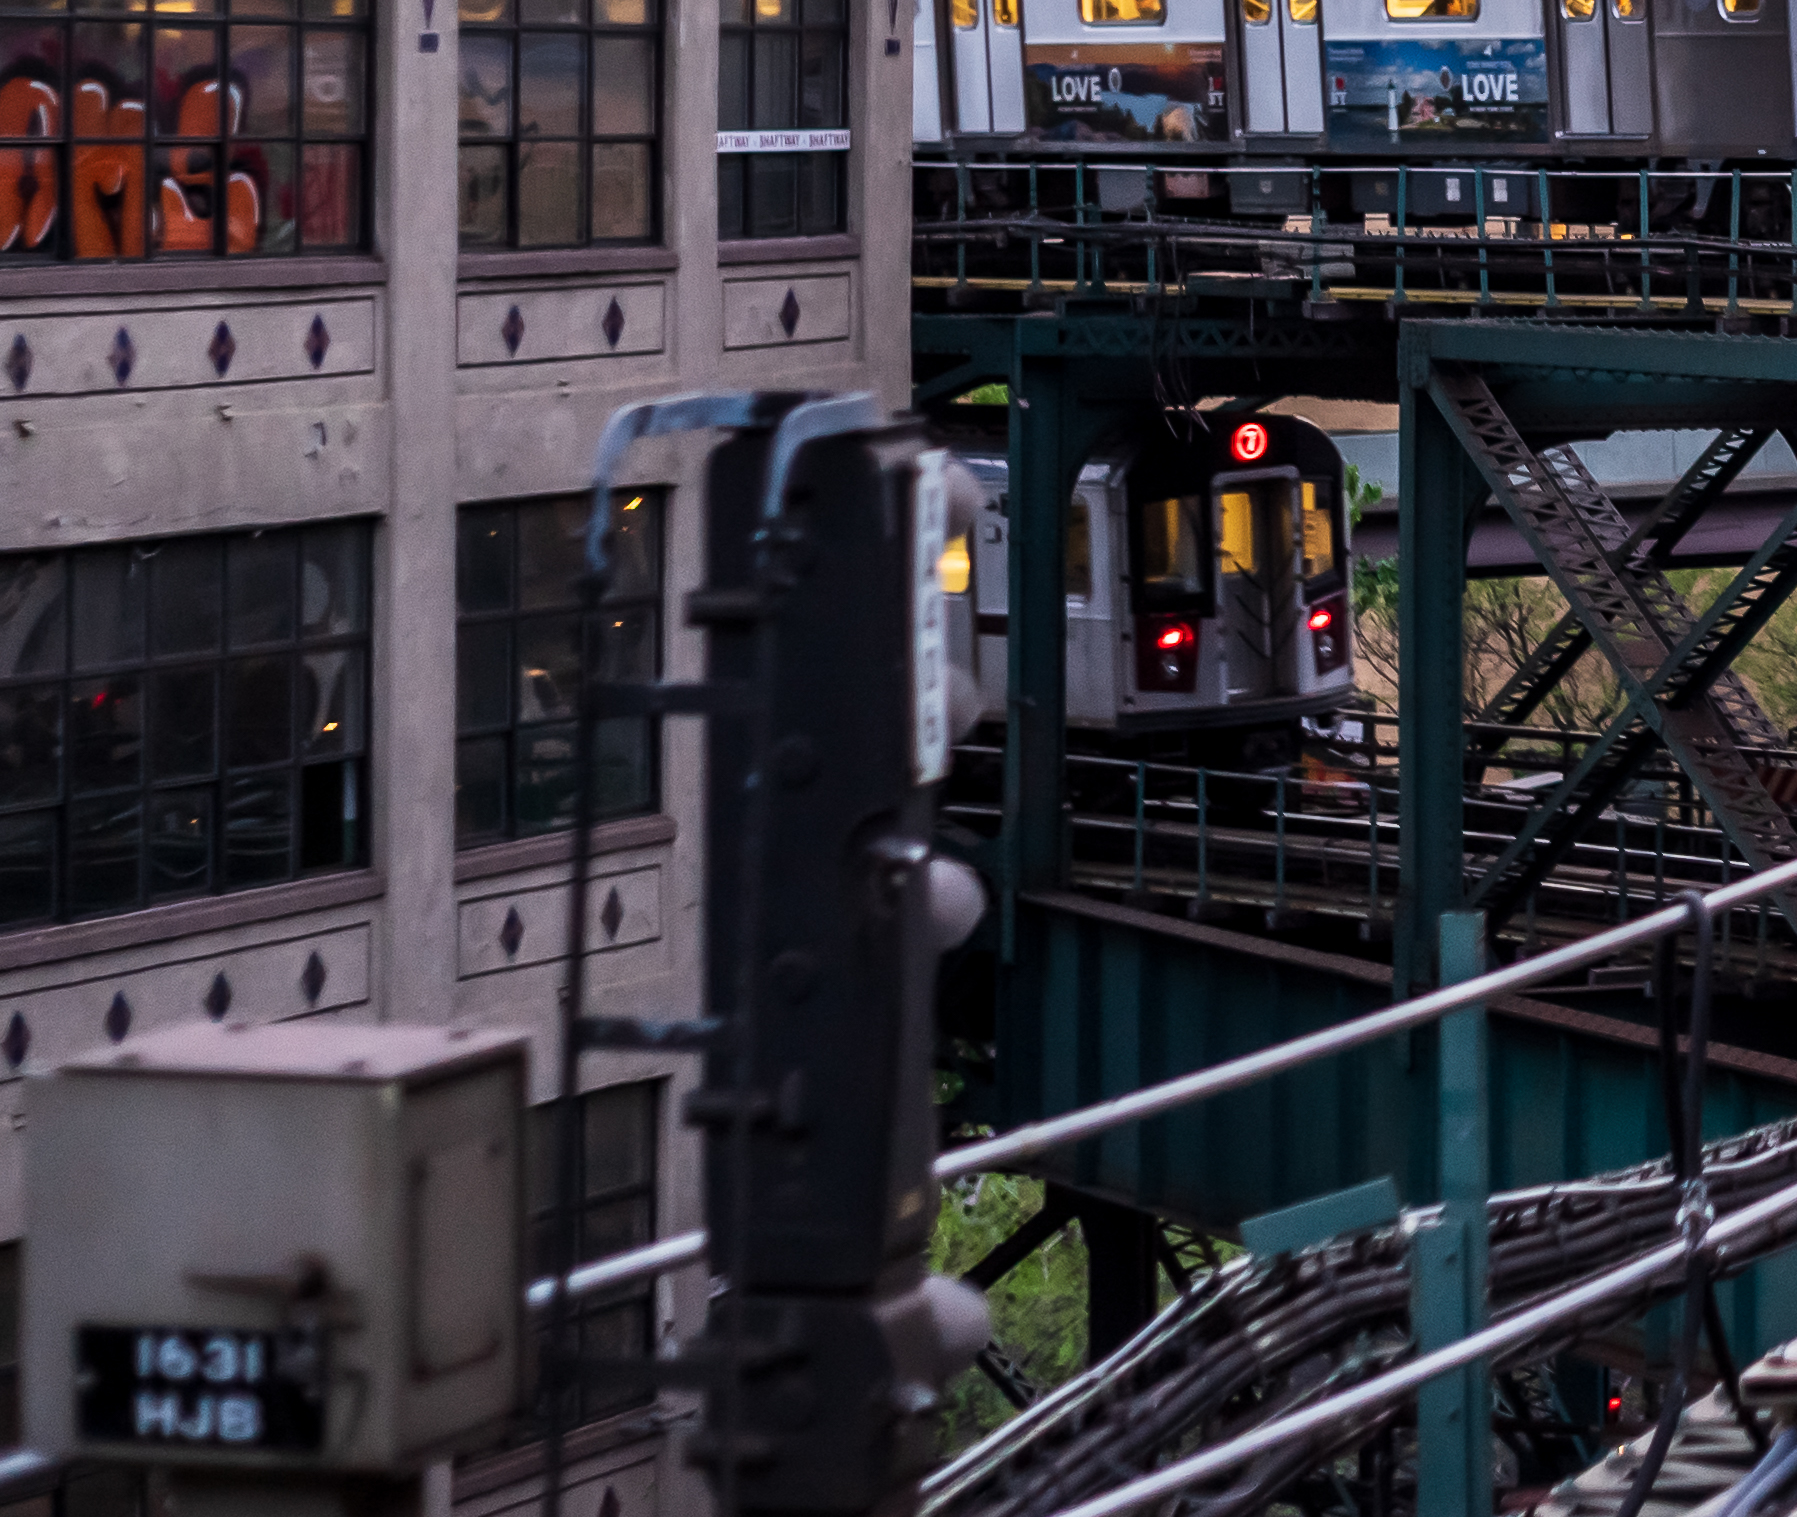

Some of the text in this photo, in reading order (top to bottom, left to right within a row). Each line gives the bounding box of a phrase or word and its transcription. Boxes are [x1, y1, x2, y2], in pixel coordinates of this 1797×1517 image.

[1051, 74, 1103, 103] LOVE
[1461, 73, 1519, 103] LOVE
[136, 1336, 263, 1382] 1631
